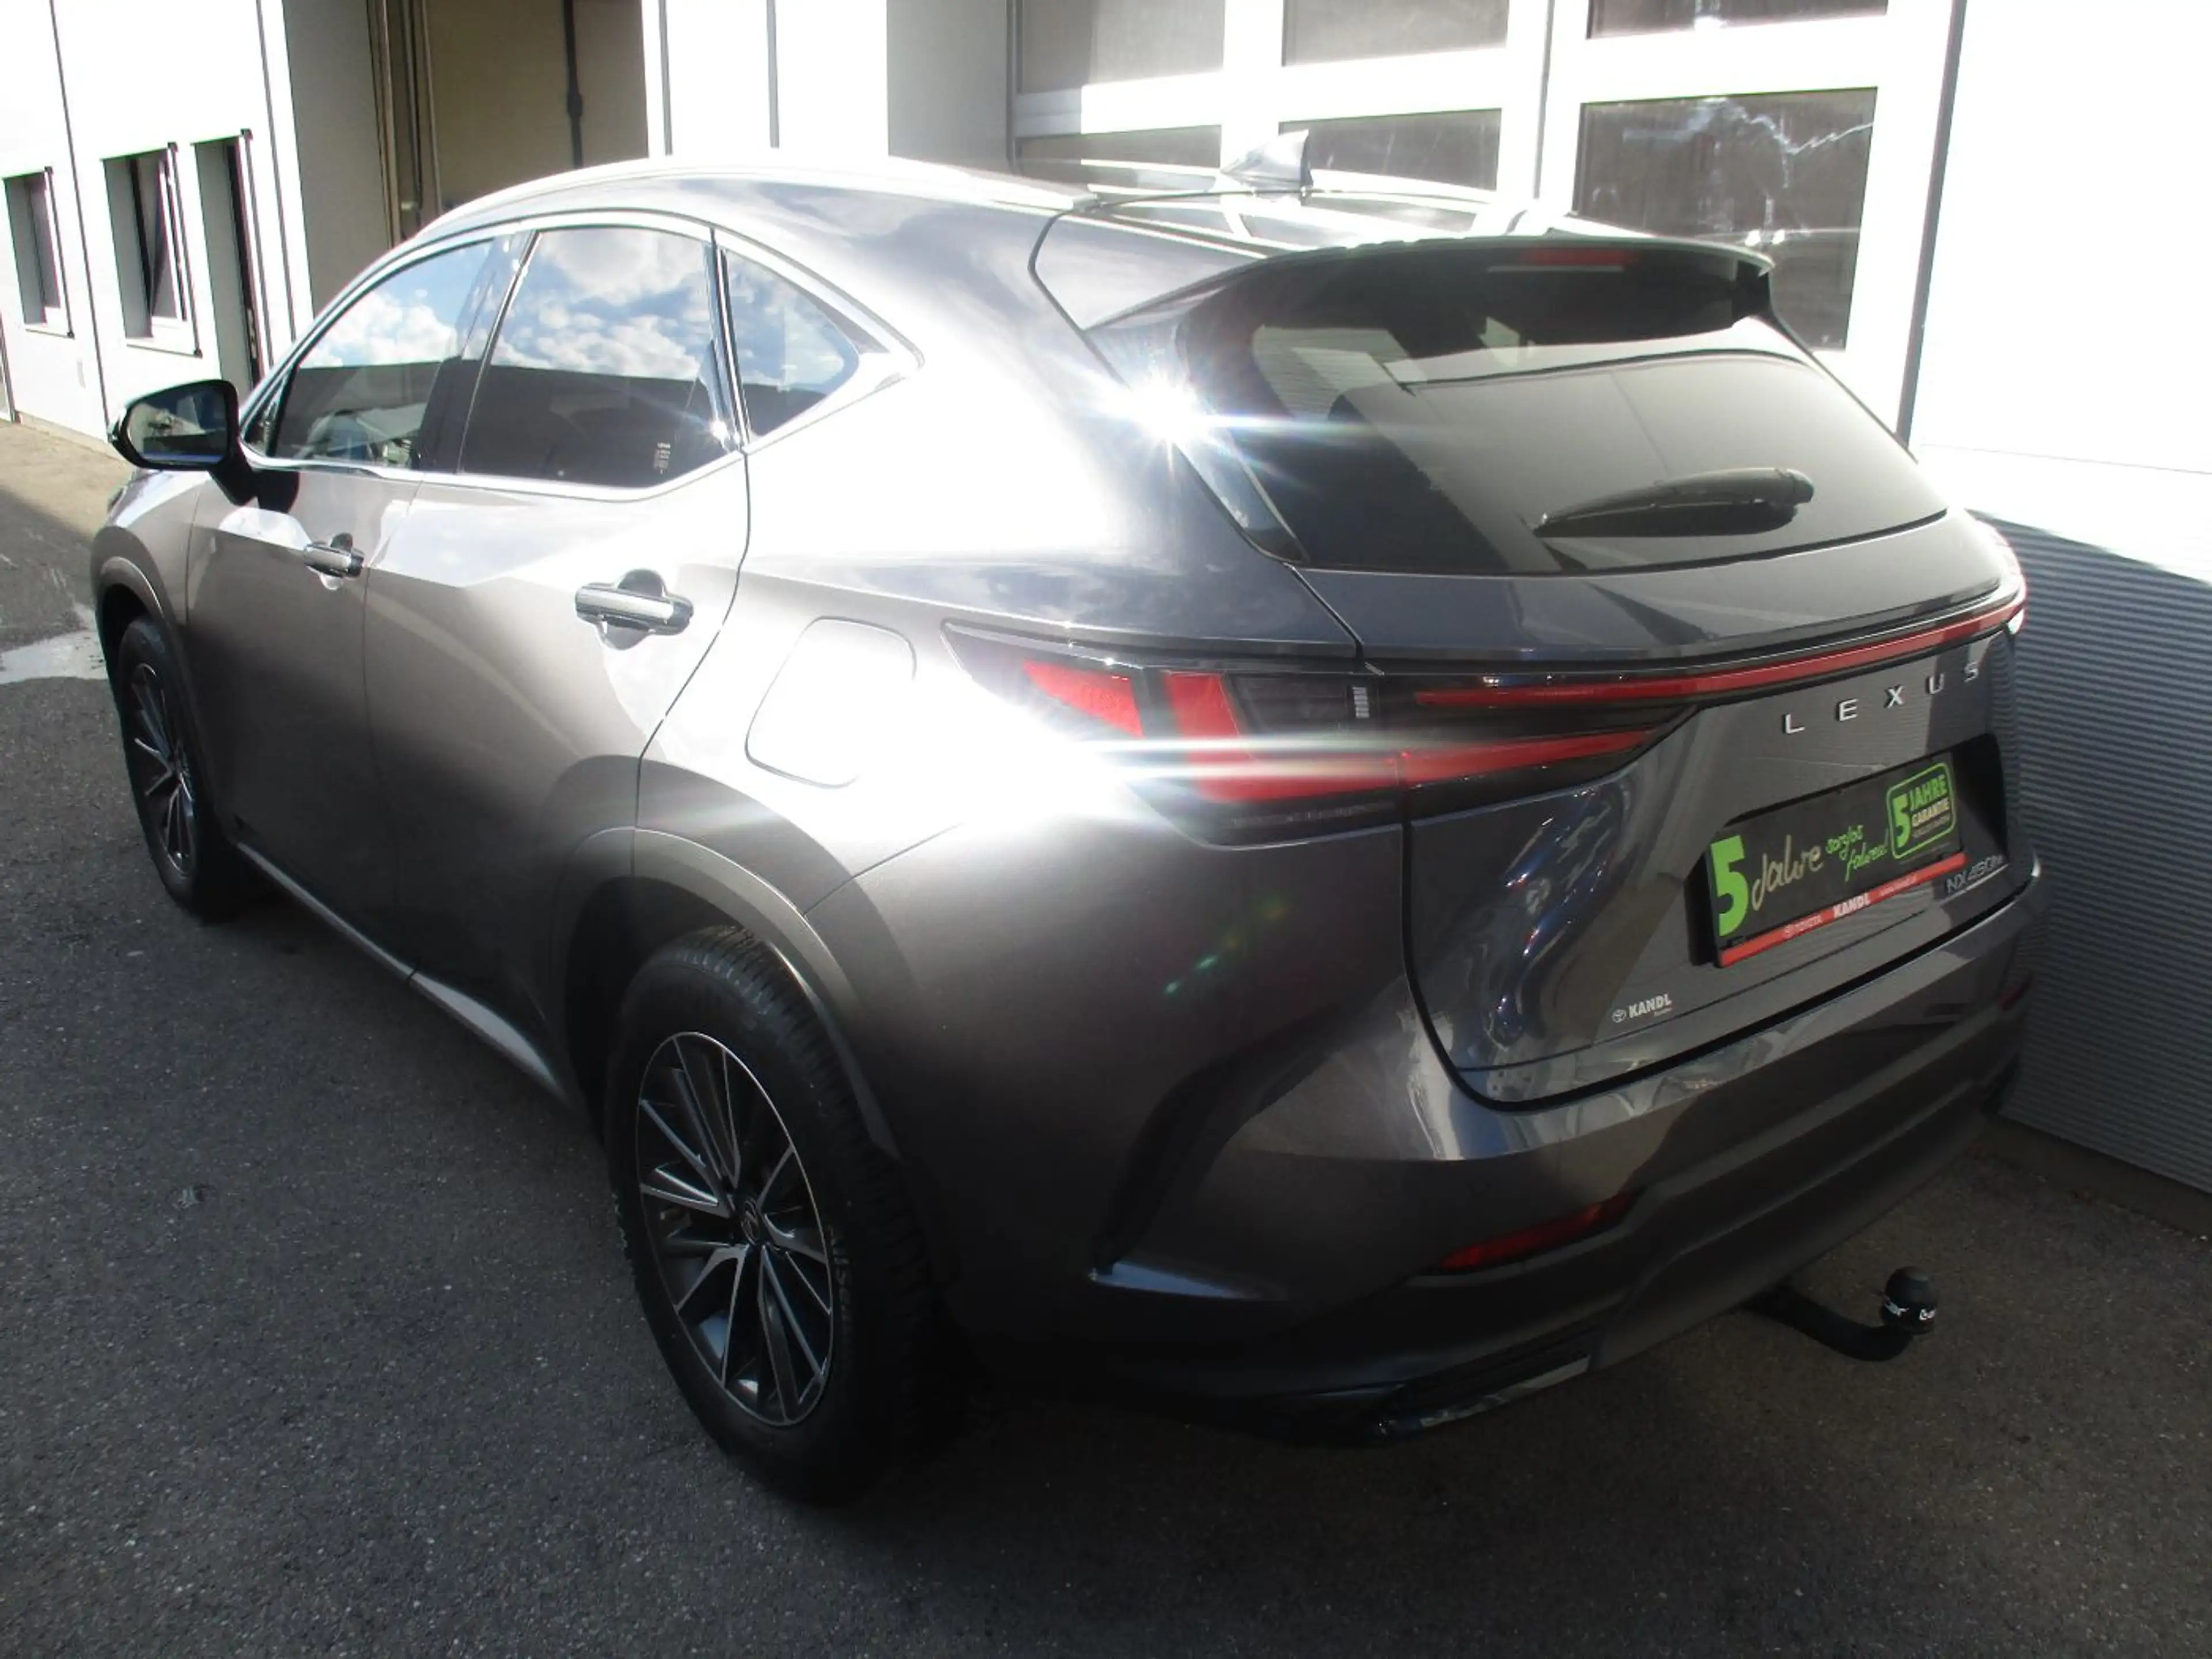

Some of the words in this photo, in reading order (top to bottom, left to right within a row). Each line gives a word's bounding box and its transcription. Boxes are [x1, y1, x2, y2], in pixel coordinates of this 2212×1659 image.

[1785, 661, 1979, 734] LEXUS
[1909, 774, 1948, 811] JAHRE
[1893, 793, 1911, 848] 5
[1711, 835, 1749, 937] 5
[1751, 834, 1824, 911] Jahre
[1946, 870, 1968, 894] NX
[1833, 892, 1871, 919] KANDL
[1628, 993, 1673, 1018] KANDL
